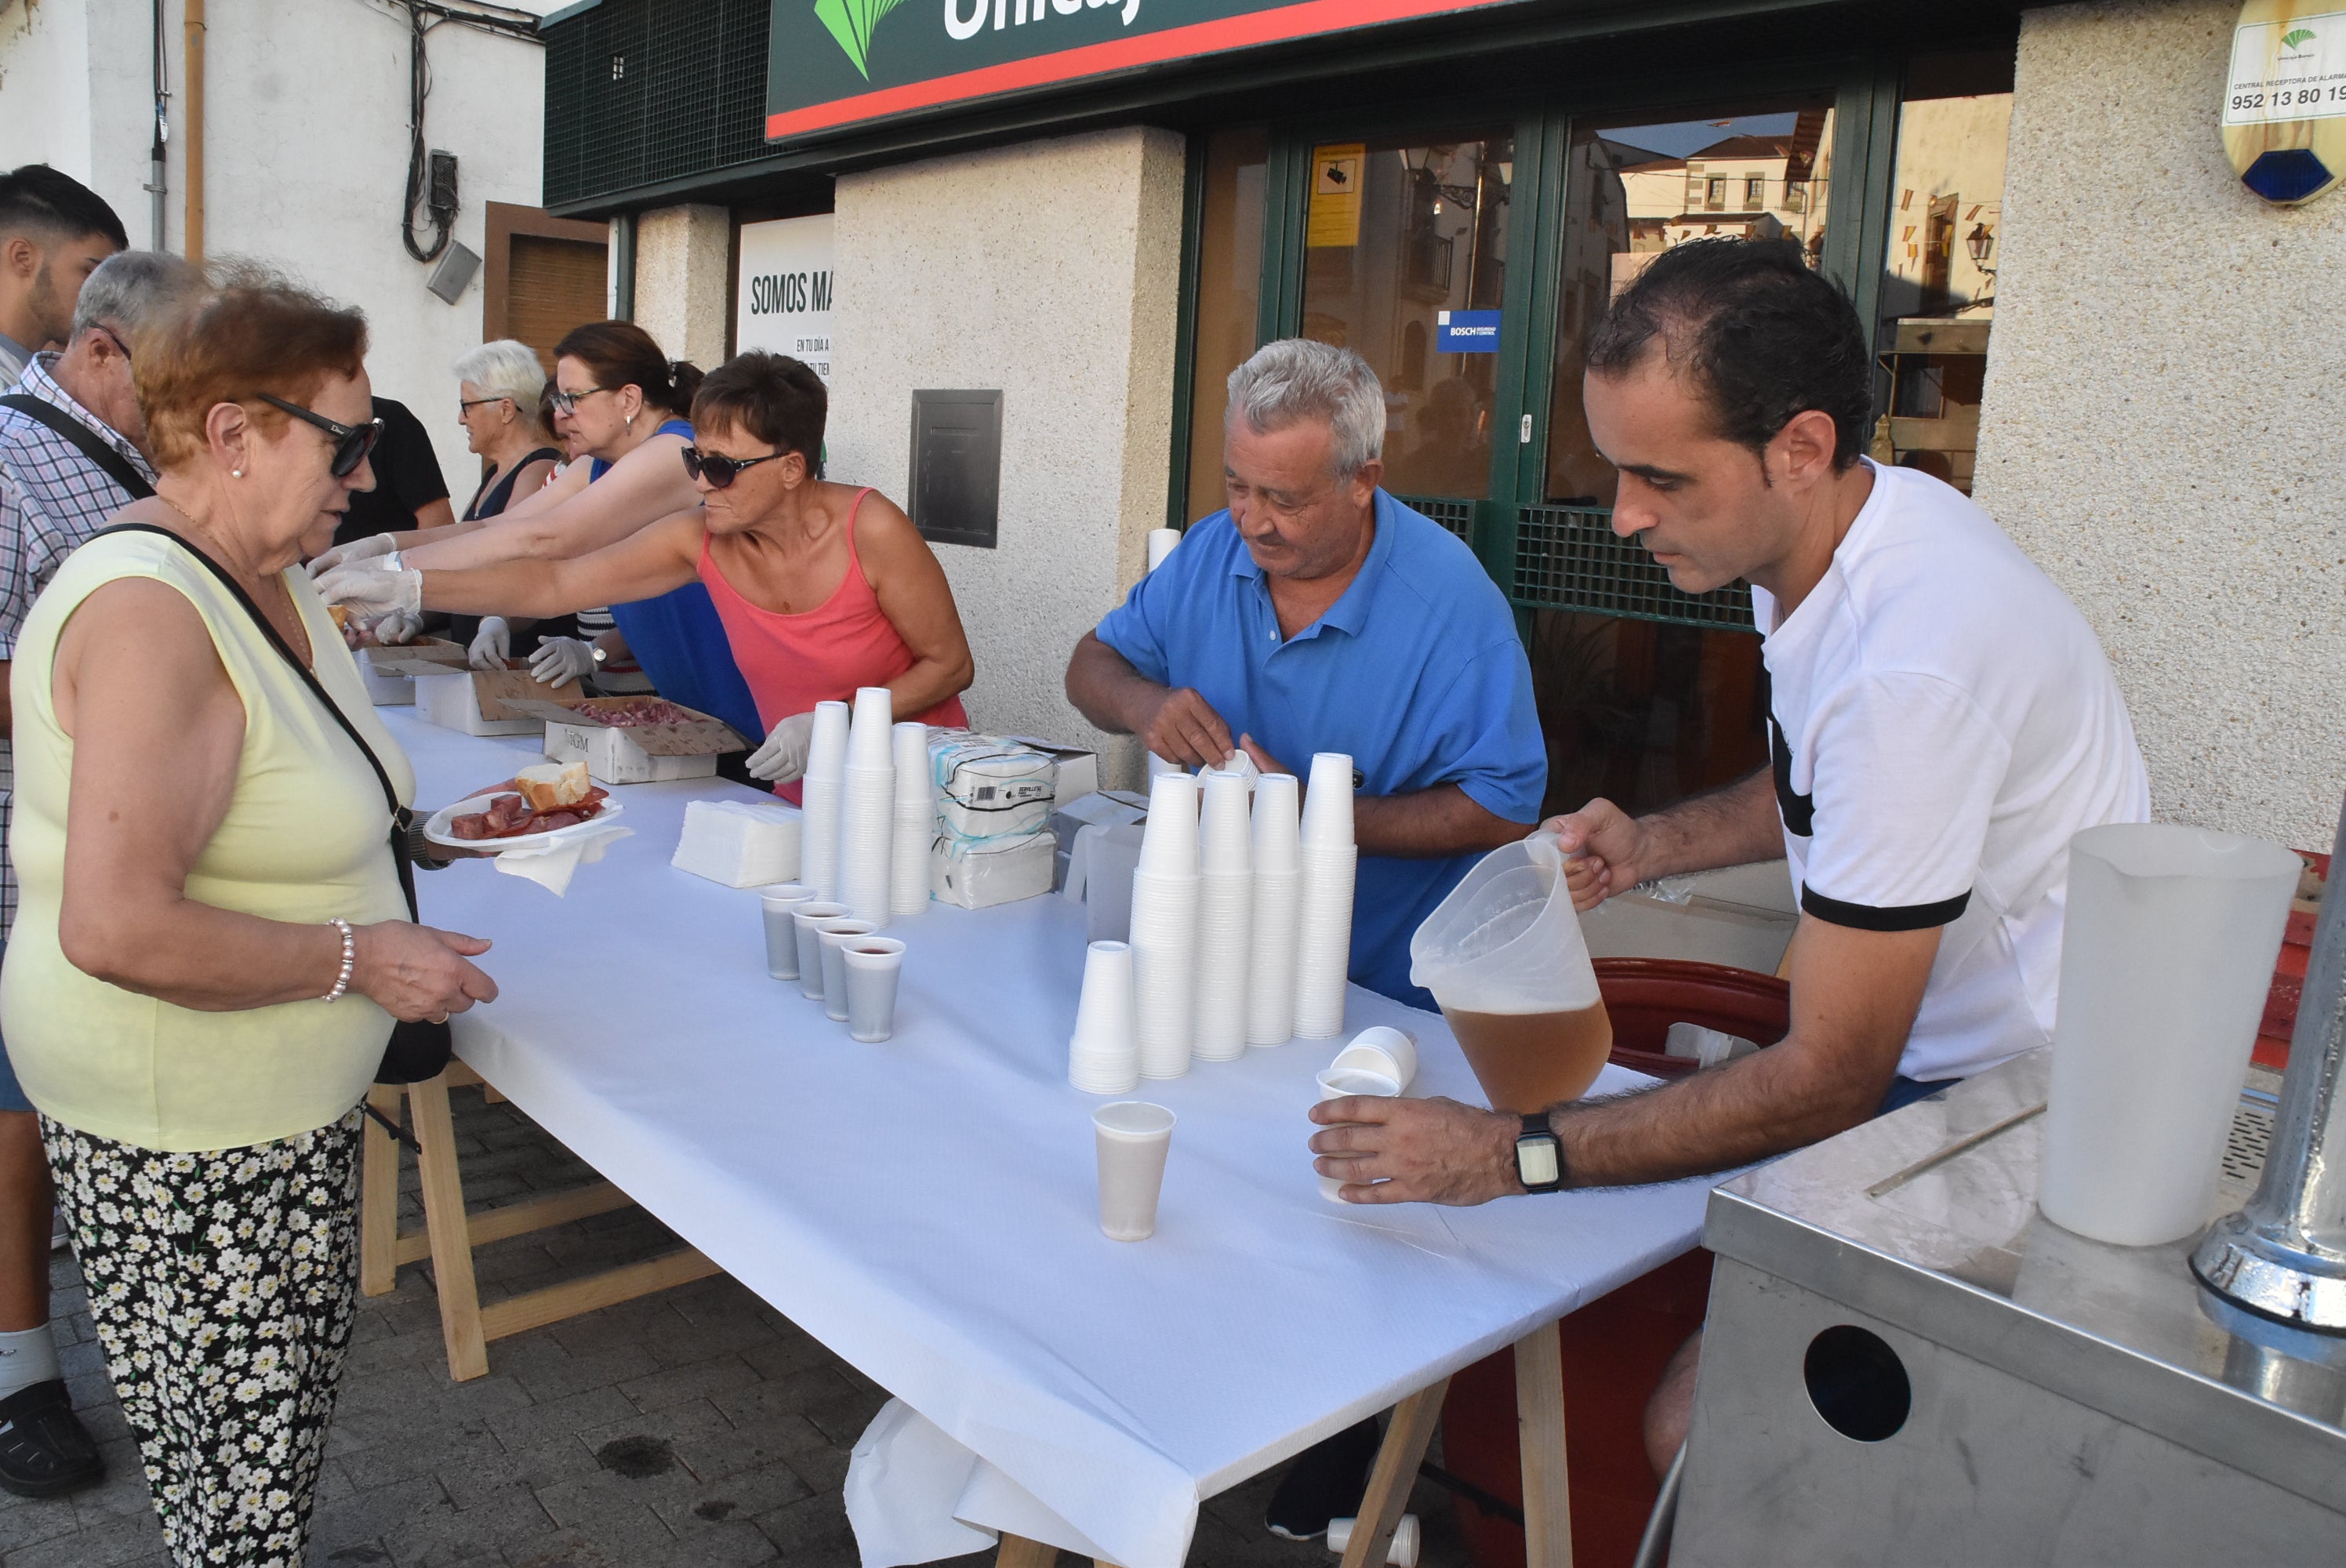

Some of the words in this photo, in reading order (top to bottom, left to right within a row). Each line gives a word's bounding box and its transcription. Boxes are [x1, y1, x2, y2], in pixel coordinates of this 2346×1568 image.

[2234, 82, 2264, 90] CENTRAL
[2265, 78, 2306, 87] RECEPTORA
[2232, 93, 2264, 111] 952
[2272, 91, 2292, 107] 13
[2297, 89, 2321, 103] 80
[751, 272, 807, 315] SOMOS
[1450, 327, 1476, 336] BOSCH
[797, 339, 804, 352] EN
[805, 339, 813, 352] TU
[814, 336, 824, 352] DÍA
[825, 338, 830, 352] A
